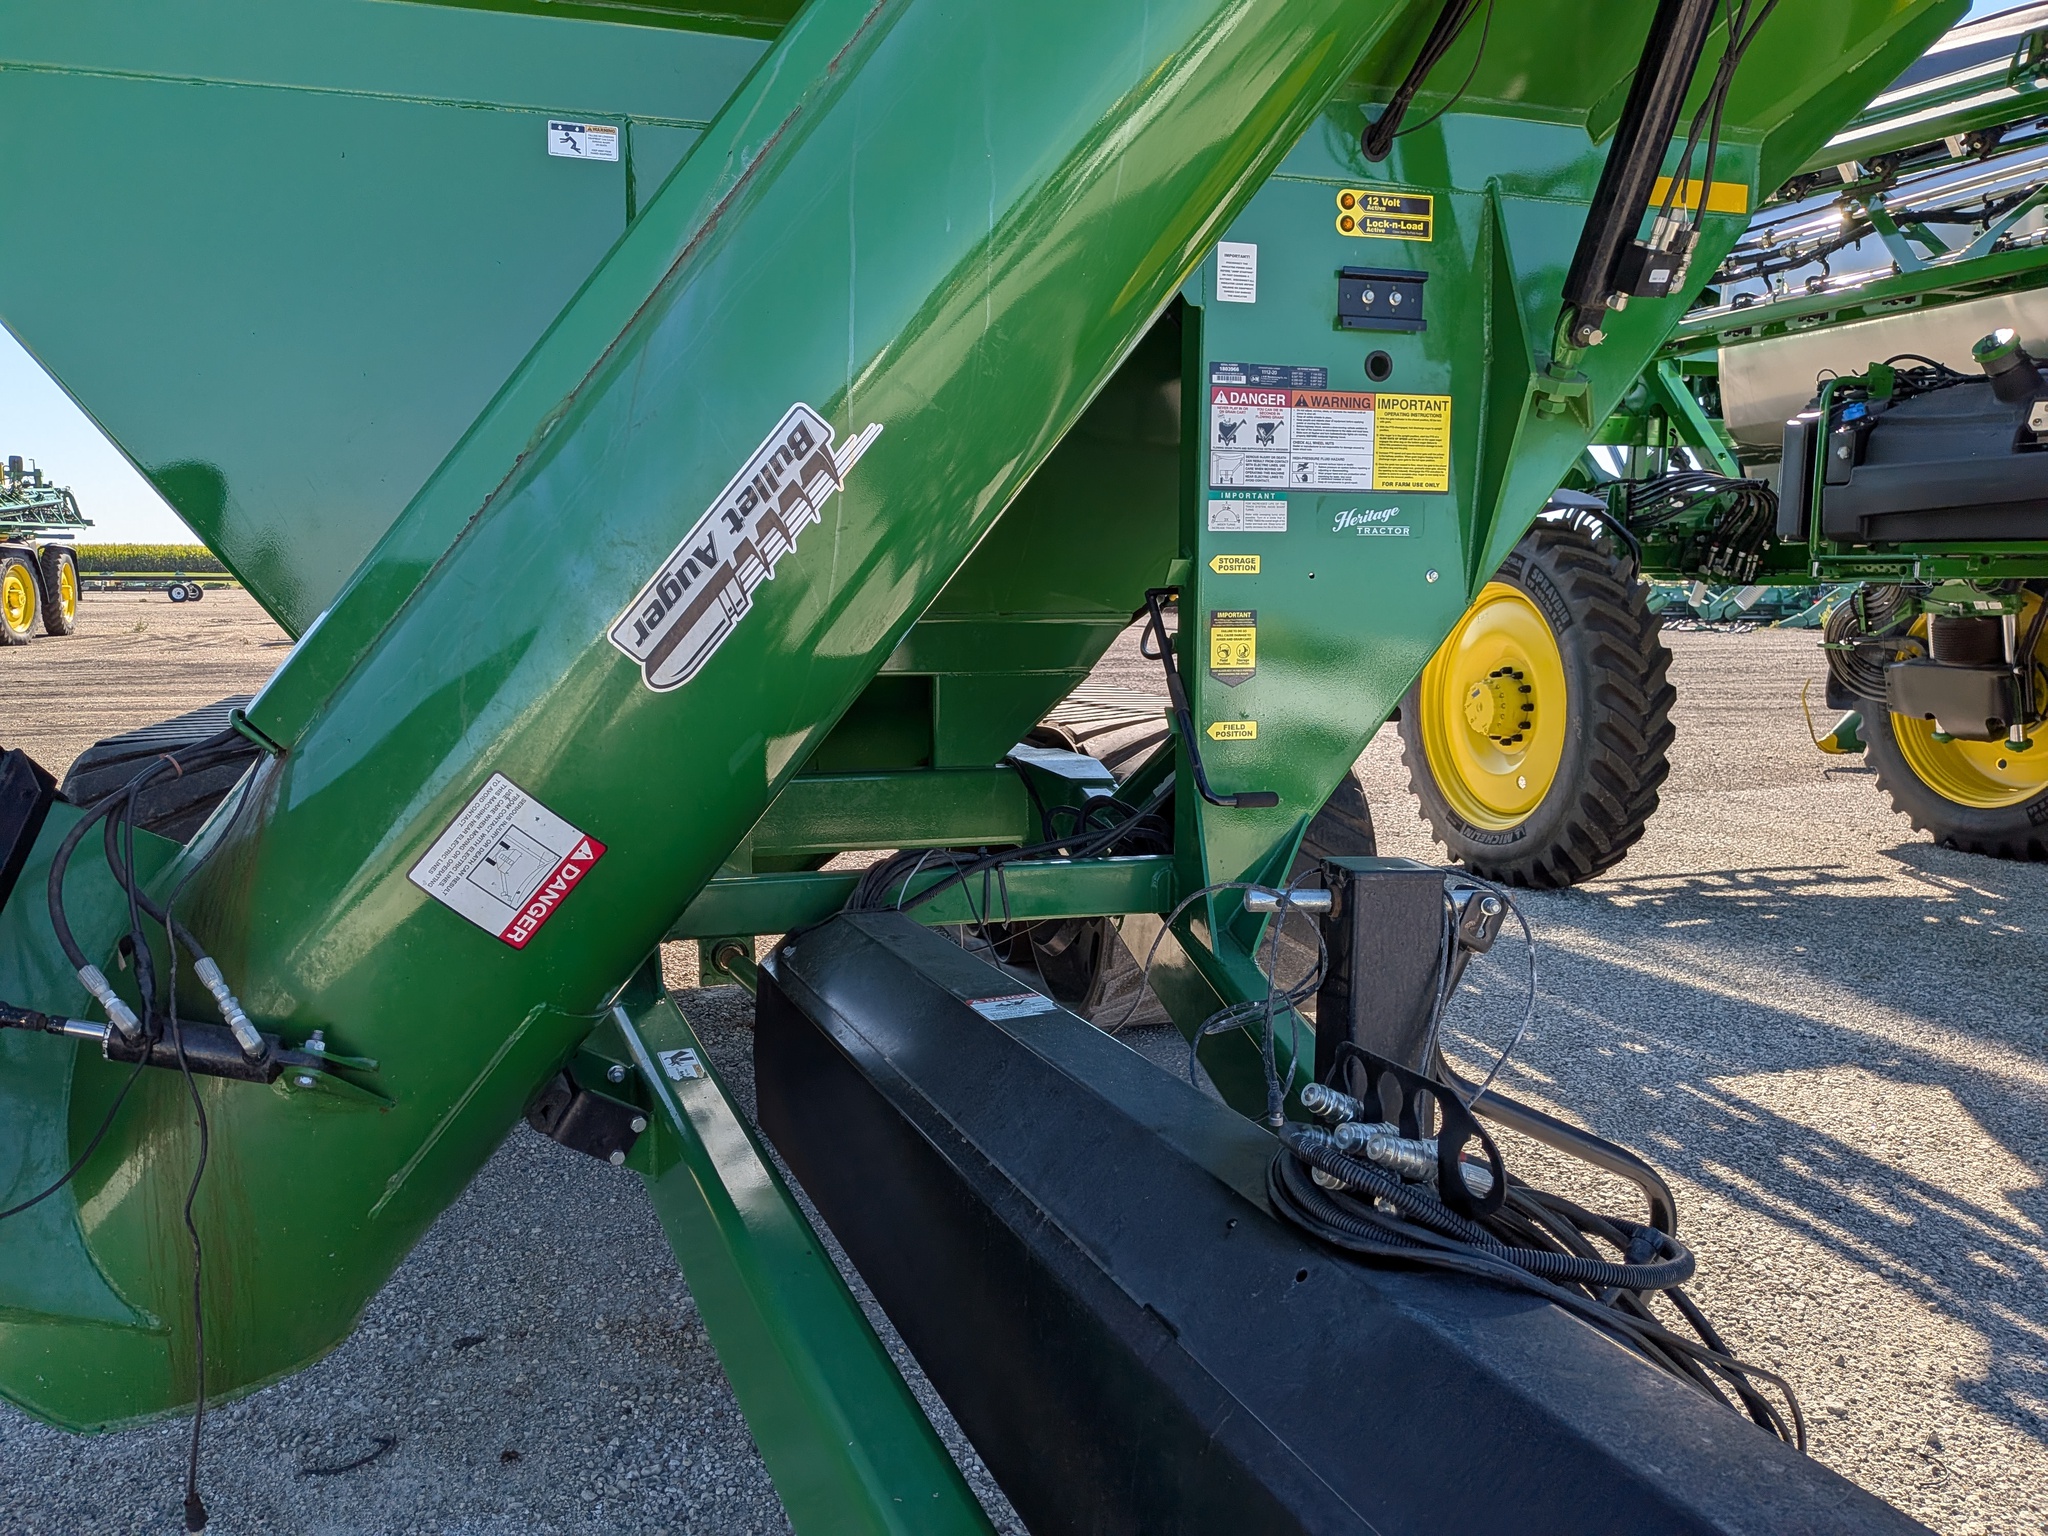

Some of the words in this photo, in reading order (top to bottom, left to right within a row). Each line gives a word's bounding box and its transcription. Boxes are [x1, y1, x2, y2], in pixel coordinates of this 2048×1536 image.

[1367, 197, 1378, 205] 12
[1381, 198, 1400, 206] Volt
[1367, 219, 1423, 230] Lock-n-Load
[1231, 392, 1285, 405] DANGER
[1311, 396, 1370, 408] WARNING
[1378, 399, 1449, 411] IMPORTANT
[721, 420, 816, 535] Bullet
[1332, 506, 1400, 532] Heritage
[1357, 527, 1409, 535] TRACTOR
[633, 531, 719, 647] Auger
[1531, 568, 1569, 623] SPRAYBIB
[1215, 730, 1253, 738] POSITION
[492, 778, 501, 787] TO
[494, 783, 507, 796] THIS
[478, 786, 494, 803] AVOID
[502, 788, 514, 800] USE
[505, 793, 520, 809] FROM
[457, 802, 481, 828] CONTACT.
[474, 795, 497, 820] MACHINE
[490, 799, 504, 815] CARE
[505, 798, 527, 821] SERIOUS
[462, 819, 477, 834] NEAR
[476, 813, 492, 830] WHEN
[485, 808, 507, 833] CONTACT
[490, 820, 508, 840] INJURY
[1464, 828, 1513, 844] MICHELIN
[441, 833, 464, 859] ELECTRIC
[459, 829, 479, 851] MOVING
[473, 832, 487, 847] WITH
[483, 839, 492, 848] OR
[452, 850, 461, 859] OR
[452, 846, 475, 872] ELECTRIC
[468, 847, 485, 865] DEATH
[427, 858, 454, 888] OPERATING
[428, 858, 443, 875] LINES
[458, 864, 470, 876] CAN
[438, 871, 454, 888] LINES.
[442, 876, 460, 896] RESULT
[506, 863, 581, 943] DANGER
